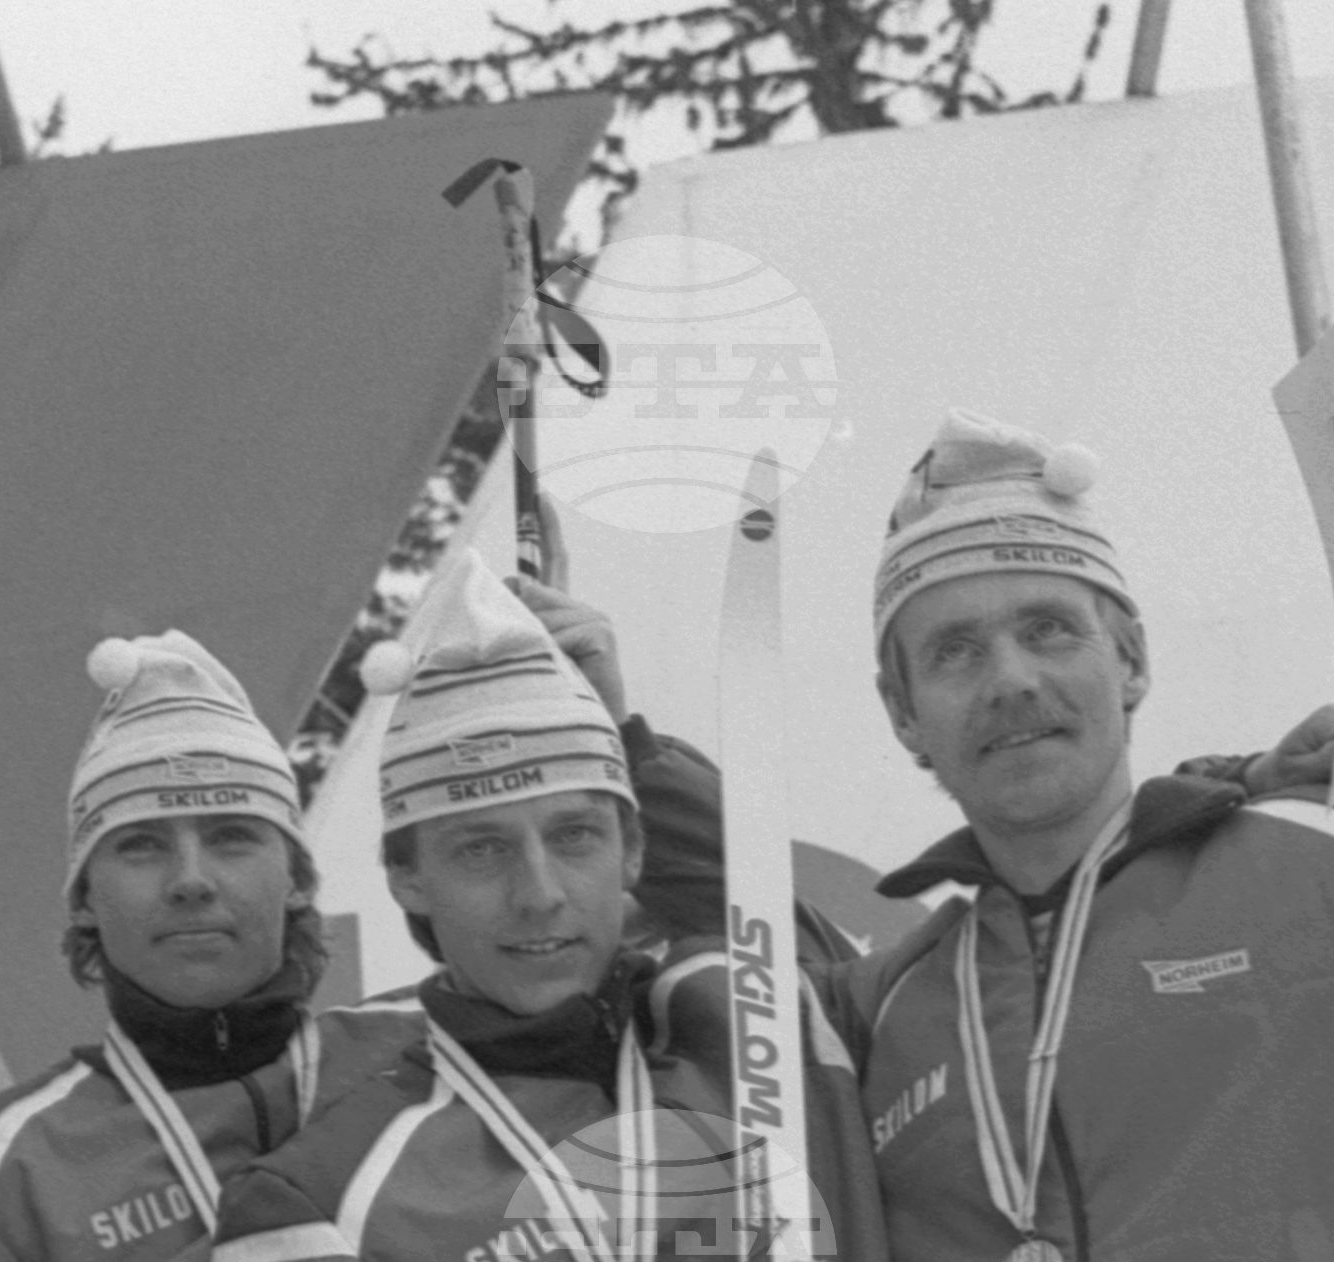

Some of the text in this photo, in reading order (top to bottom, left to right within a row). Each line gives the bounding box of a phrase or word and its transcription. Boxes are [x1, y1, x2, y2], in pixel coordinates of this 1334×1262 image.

[992, 548, 1087, 569] SKILOM
[157, 789, 250, 809] SKILOM
[446, 766, 544, 802] SKILOM
[1158, 953, 1244, 986] NORHEIM
[873, 1062, 948, 1154] SKILOM
[90, 1183, 193, 1250] SKILO
